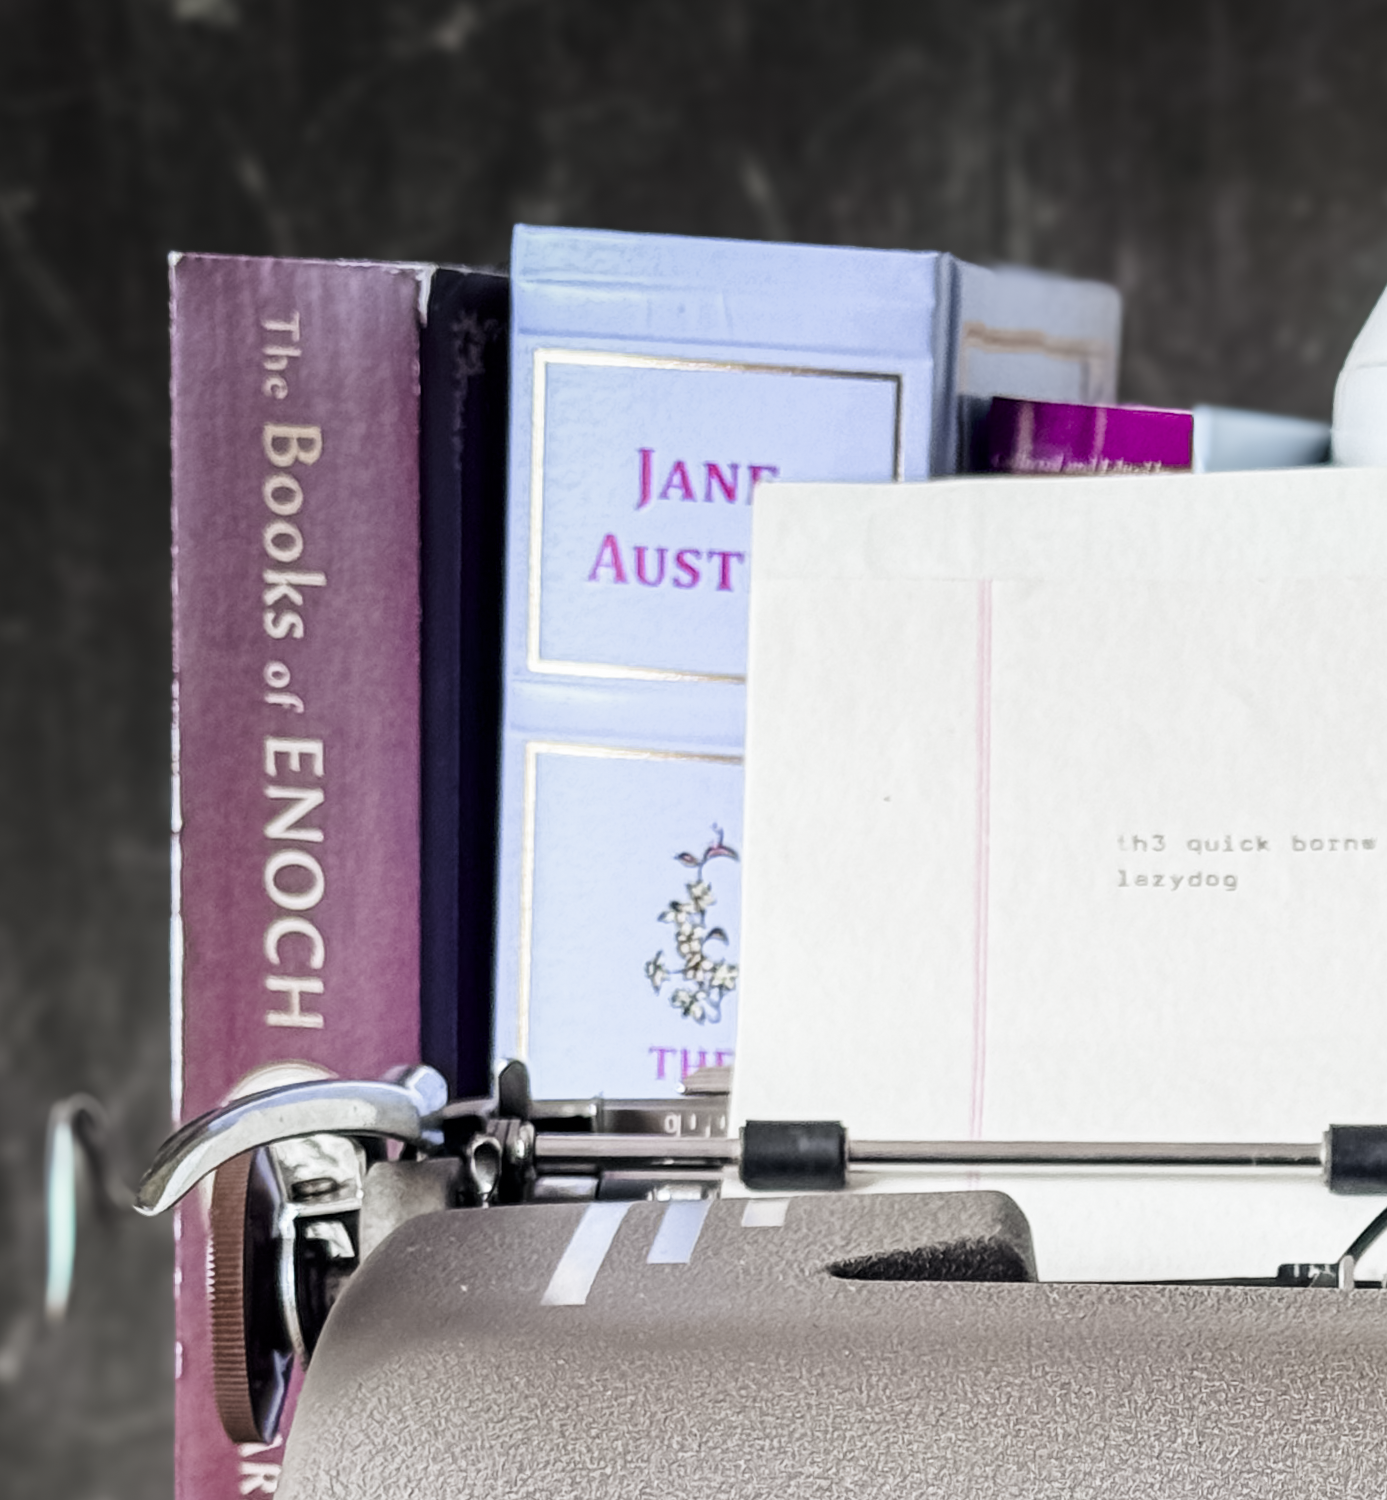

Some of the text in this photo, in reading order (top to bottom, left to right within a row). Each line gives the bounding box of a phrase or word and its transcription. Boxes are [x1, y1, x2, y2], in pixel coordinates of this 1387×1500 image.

[587, 532, 746, 592] AUST
[260, 311, 327, 1030] The Books of ENOCH
[1187, 834, 1270, 855] quick
[1117, 869, 1238, 891] lazydog
